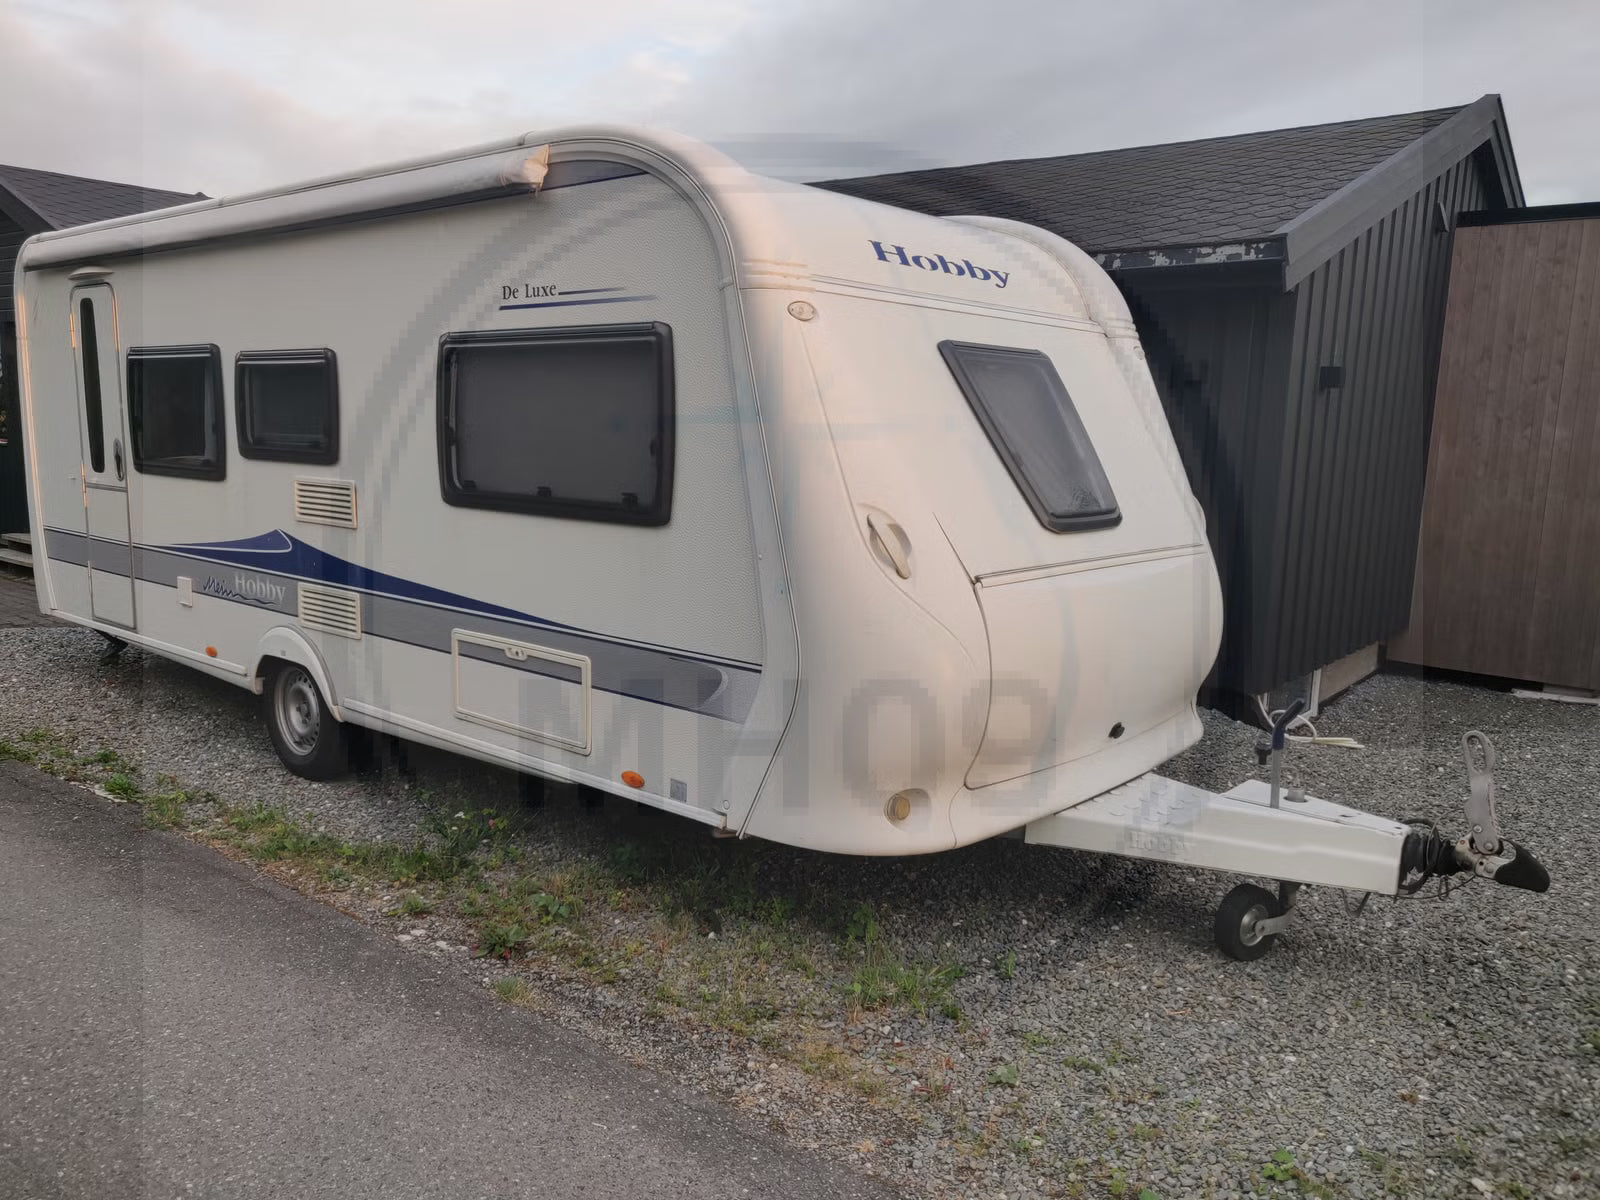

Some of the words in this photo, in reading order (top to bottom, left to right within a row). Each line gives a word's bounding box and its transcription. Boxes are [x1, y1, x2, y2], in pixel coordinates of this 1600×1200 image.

[867, 239, 1010, 289] Hobby
[502, 285, 519, 300] De
[525, 283, 556, 298] Luxe
[203, 576, 243, 599] Mein
[234, 574, 286, 602] Hobby
